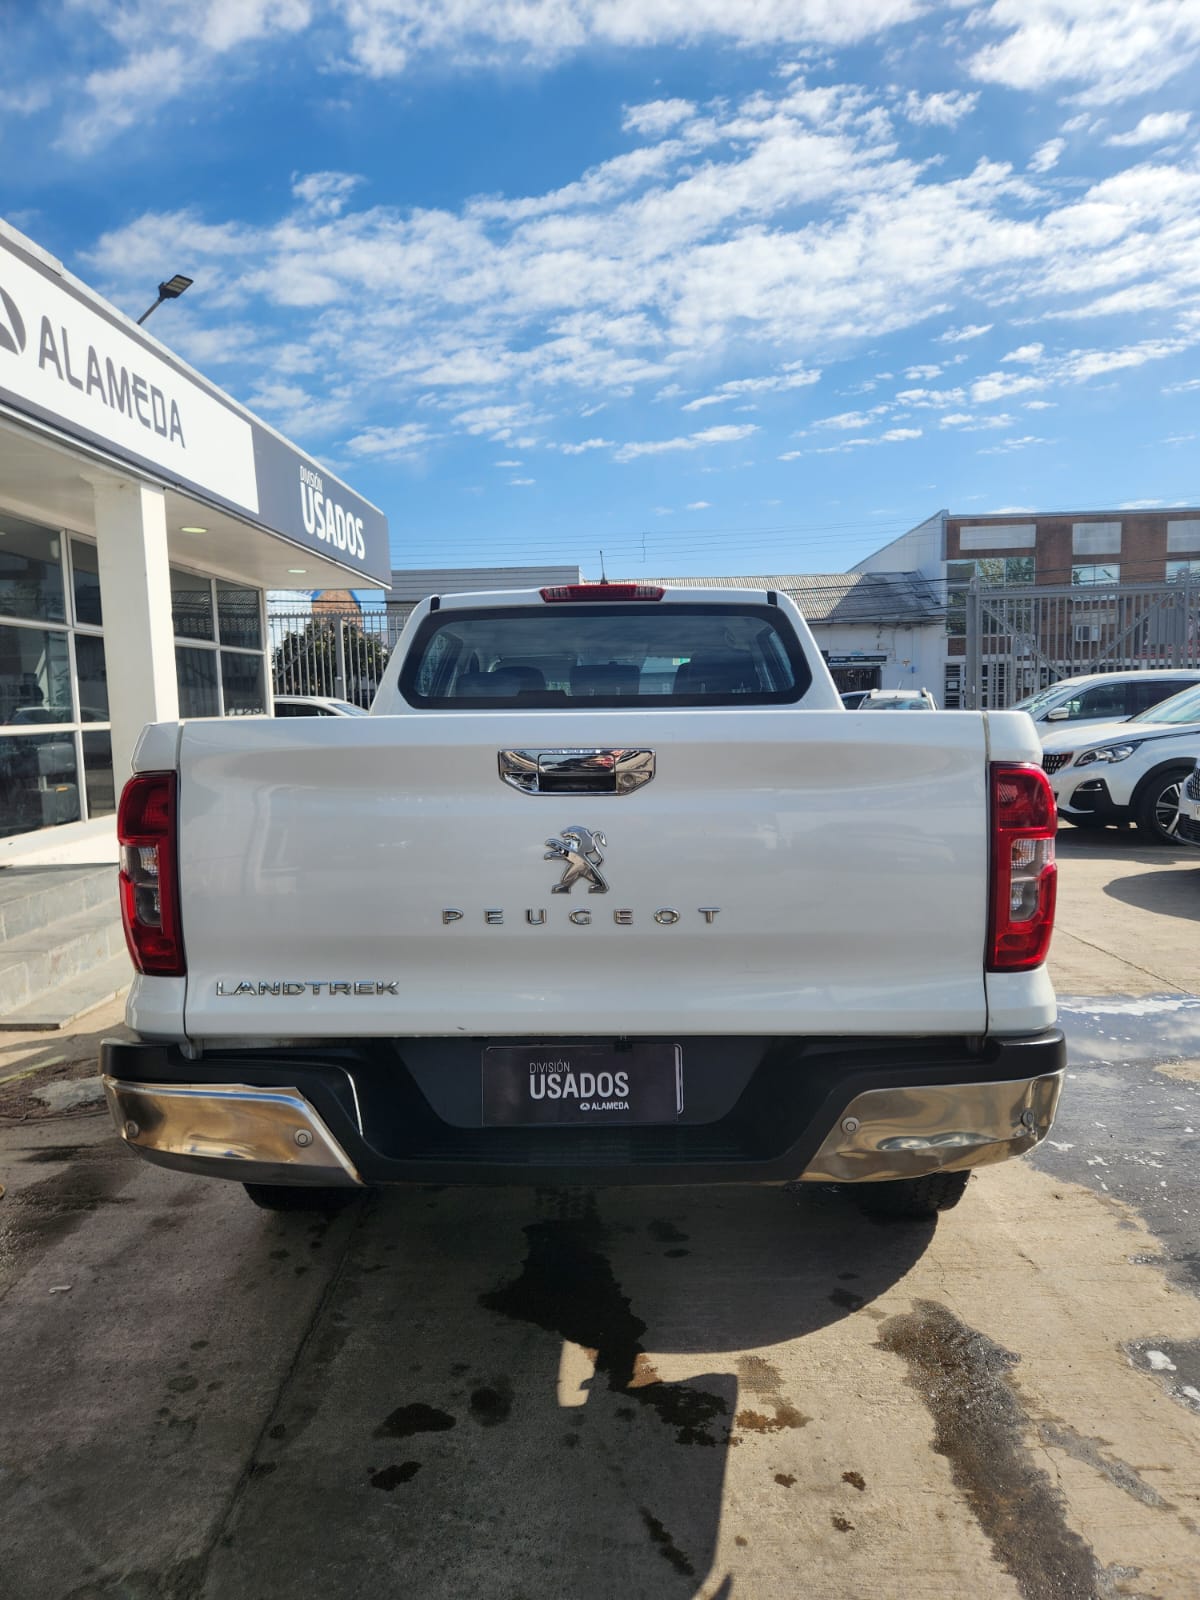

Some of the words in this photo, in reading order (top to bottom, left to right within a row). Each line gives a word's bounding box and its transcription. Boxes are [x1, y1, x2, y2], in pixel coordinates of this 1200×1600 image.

[38, 315, 186, 449] ALAMEDA
[300, 481, 366, 560] USADOS
[442, 907, 721, 925] PEUGEOT
[216, 981, 400, 996] LANDTREK
[529, 1059, 570, 1073] DIVISIÓN
[529, 1072, 630, 1099] USADOS
[591, 1101, 630, 1111] ALAMEDA
